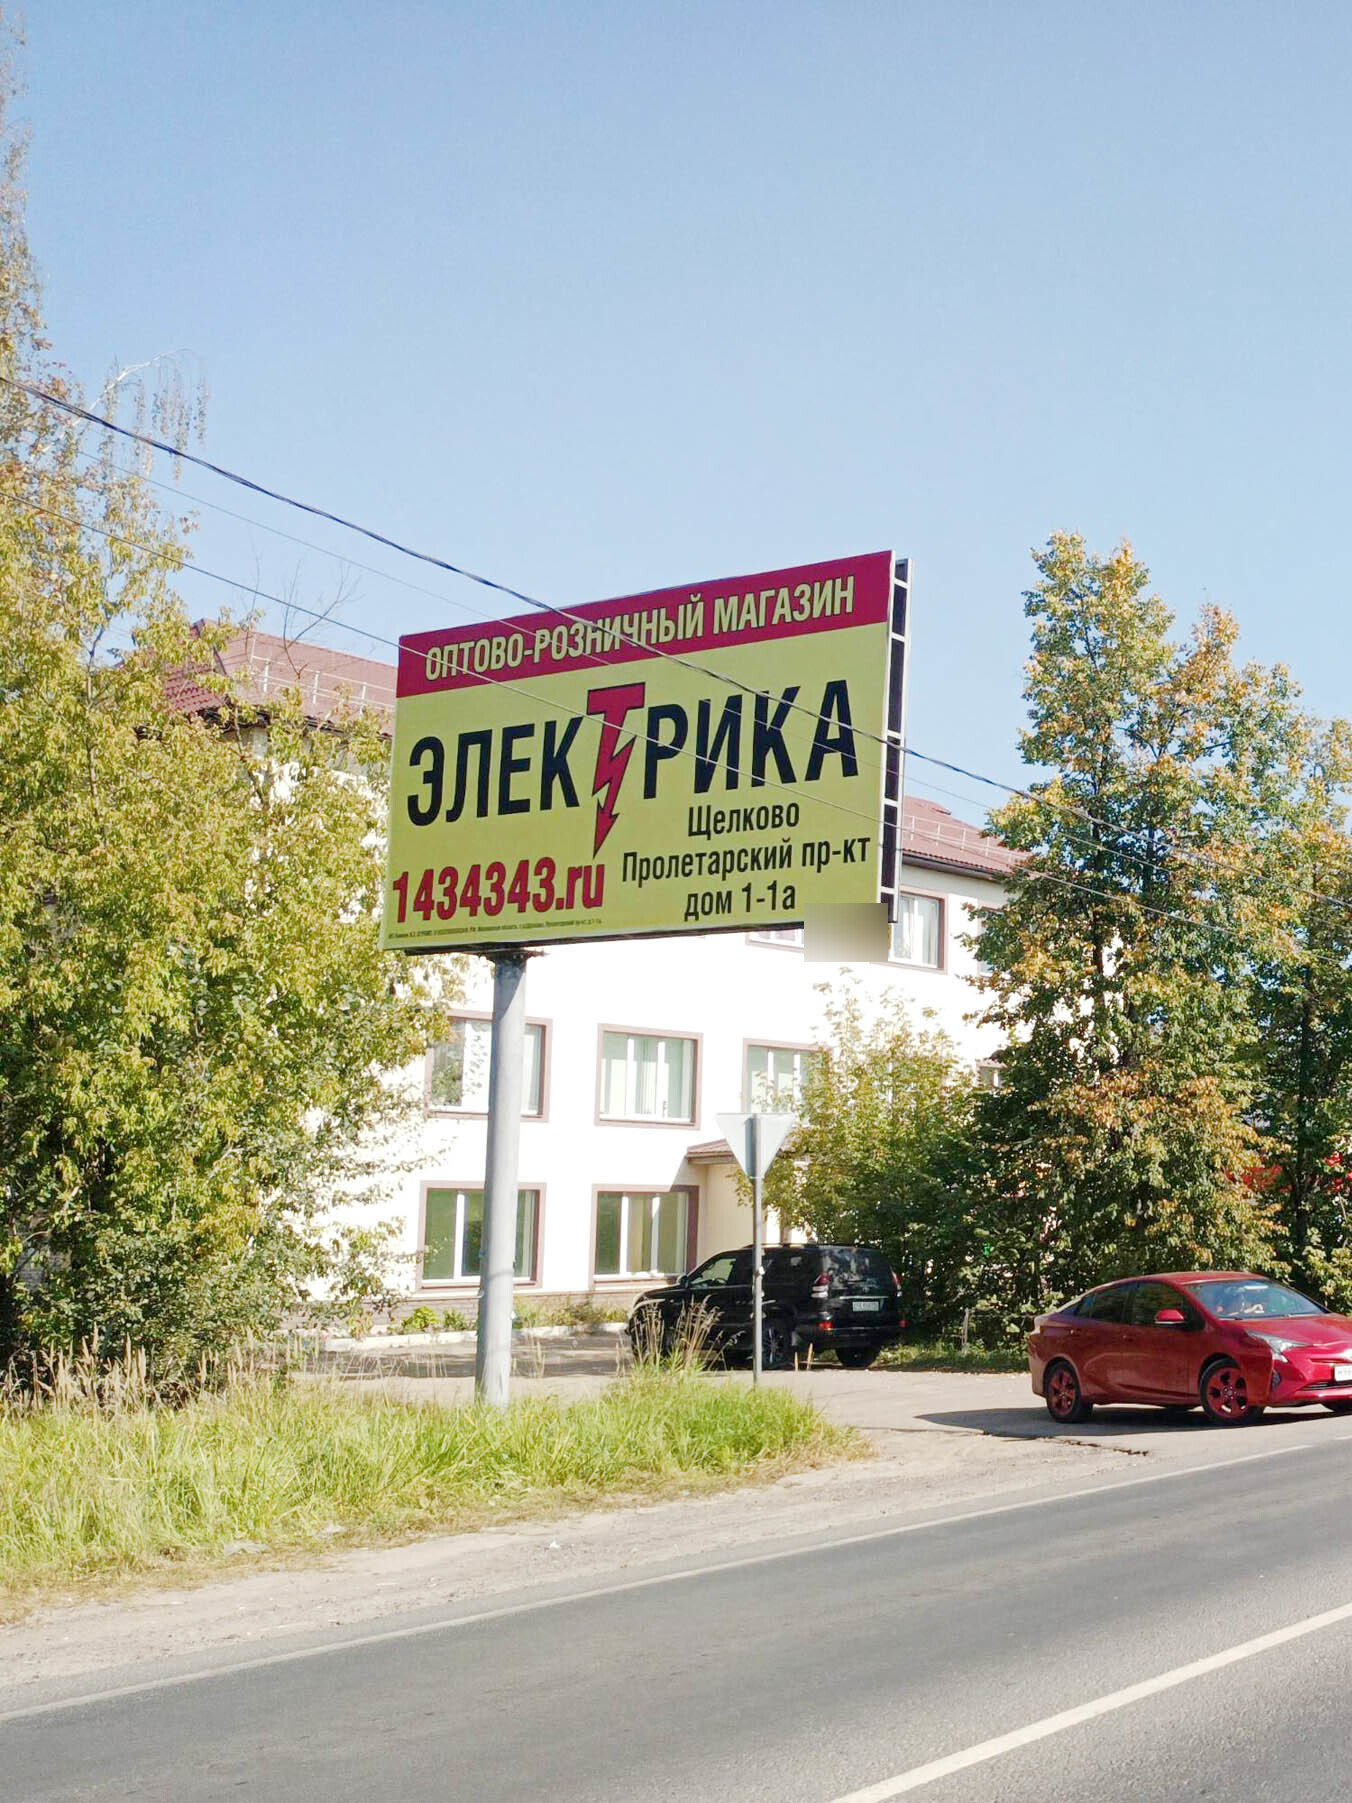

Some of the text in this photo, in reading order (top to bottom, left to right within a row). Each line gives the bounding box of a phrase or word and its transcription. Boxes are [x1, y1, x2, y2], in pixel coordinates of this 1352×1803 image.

[425, 575, 855, 681] ОПТОВО-РОЗНИЧНЫЙ МАГАЗИН
[407, 679, 860, 859] ЭЛЕКТРИКА
[687, 802, 800, 841] Щелково
[392, 856, 606, 923] 1434343.ru
[621, 836, 871, 889] Пролетарский пр-кт
[684, 879, 797, 922] дом 1-1а
